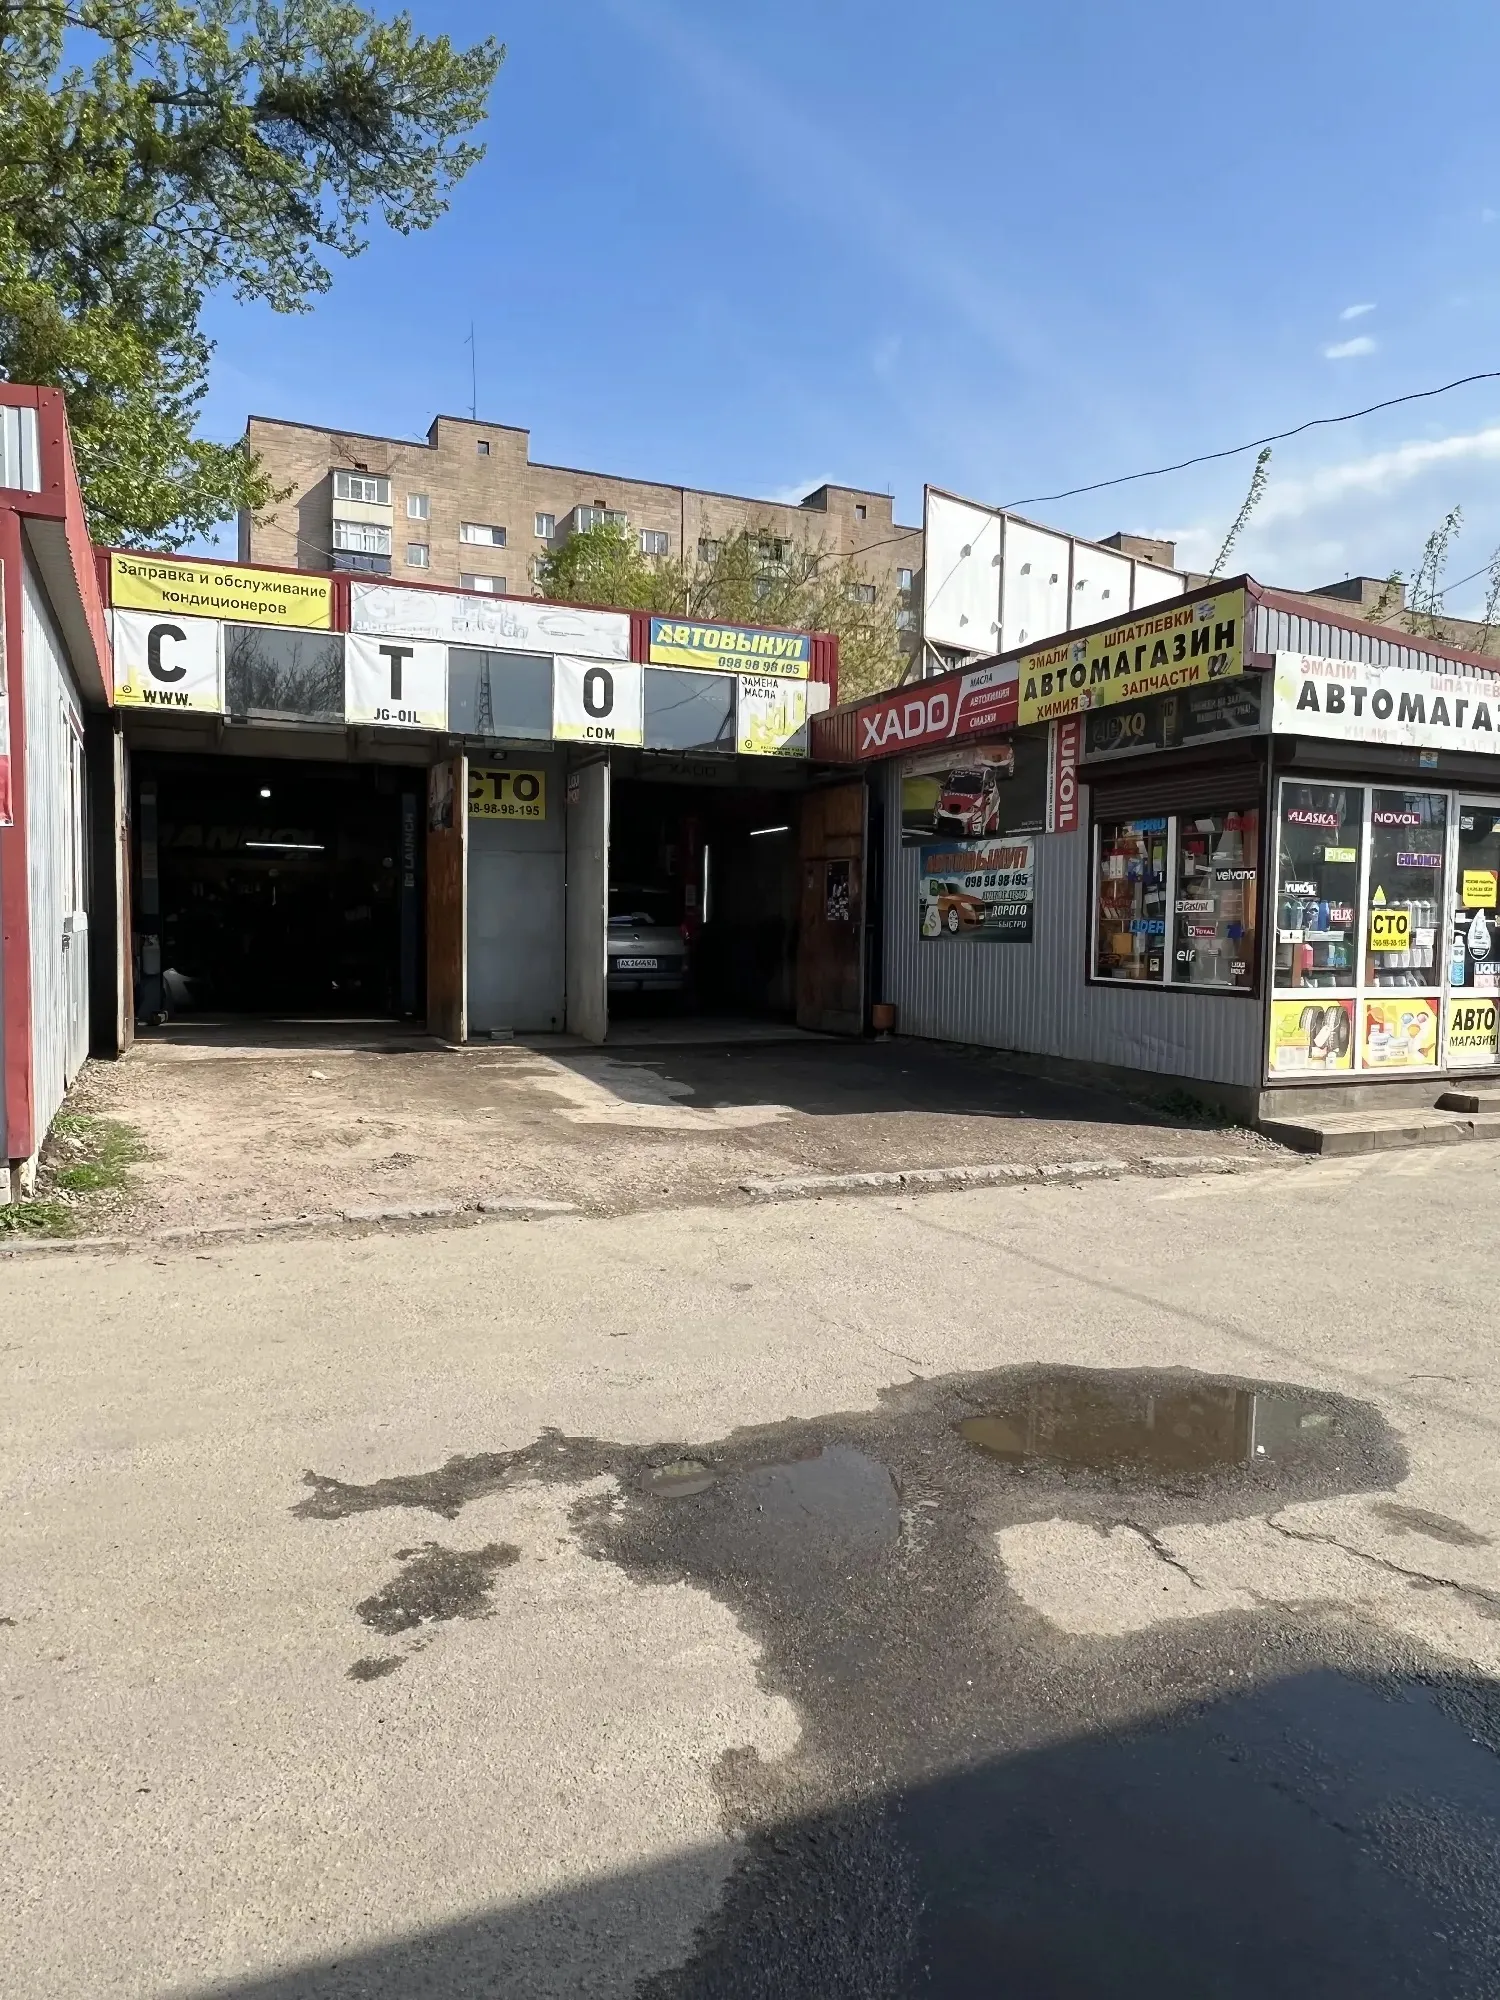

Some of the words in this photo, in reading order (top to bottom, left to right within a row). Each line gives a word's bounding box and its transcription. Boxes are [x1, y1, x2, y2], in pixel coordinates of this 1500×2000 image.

[117, 560, 194, 583] Заправка
[201, 574, 210, 584] и
[214, 574, 327, 599] обслуживание
[161, 590, 287, 615] кондиционеров
[1104, 608, 1194, 649] ШПАТЛЕВКИ
[656, 624, 803, 657] АВТОВЫКУП
[148, 623, 187, 683] С
[379, 644, 414, 701] Т
[718, 656, 742, 669] 098
[1024, 619, 1236, 702] АВТОМАГАЗИН
[1028, 648, 1069, 671] ЭМАЛИ
[1300, 659, 1357, 681] ЭМАЛИ
[742, 676, 779, 689] ЗАМЕНА
[1121, 665, 1199, 697] ЗАПЧАСТИ
[744, 688, 776, 700] МАСЛА
[143, 690, 193, 706] WWW.
[373, 707, 421, 725] JG-OIL
[582, 726, 615, 741] .COM
[1037, 696, 1078, 719] ХИМИЯ
[1296, 680, 1500, 732] АВТОМАГА
[862, 693, 949, 750] XADO
[468, 770, 540, 802] СТО
[1059, 722, 1076, 828] LUKOIL
[1288, 811, 1336, 825] ALASKA
[1374, 812, 1419, 824] NOVOL
[965, 876, 982, 888] 098
[984, 875, 996, 887] 98
[1216, 868, 1256, 881] velvana
[991, 904, 1027, 918] ДОРОГО
[1373, 914, 1408, 934] СТО
[1176, 950, 1196, 962] elf
[1451, 1007, 1496, 1031] АВТО
[1450, 1035, 1497, 1047] МАГАЗИН
